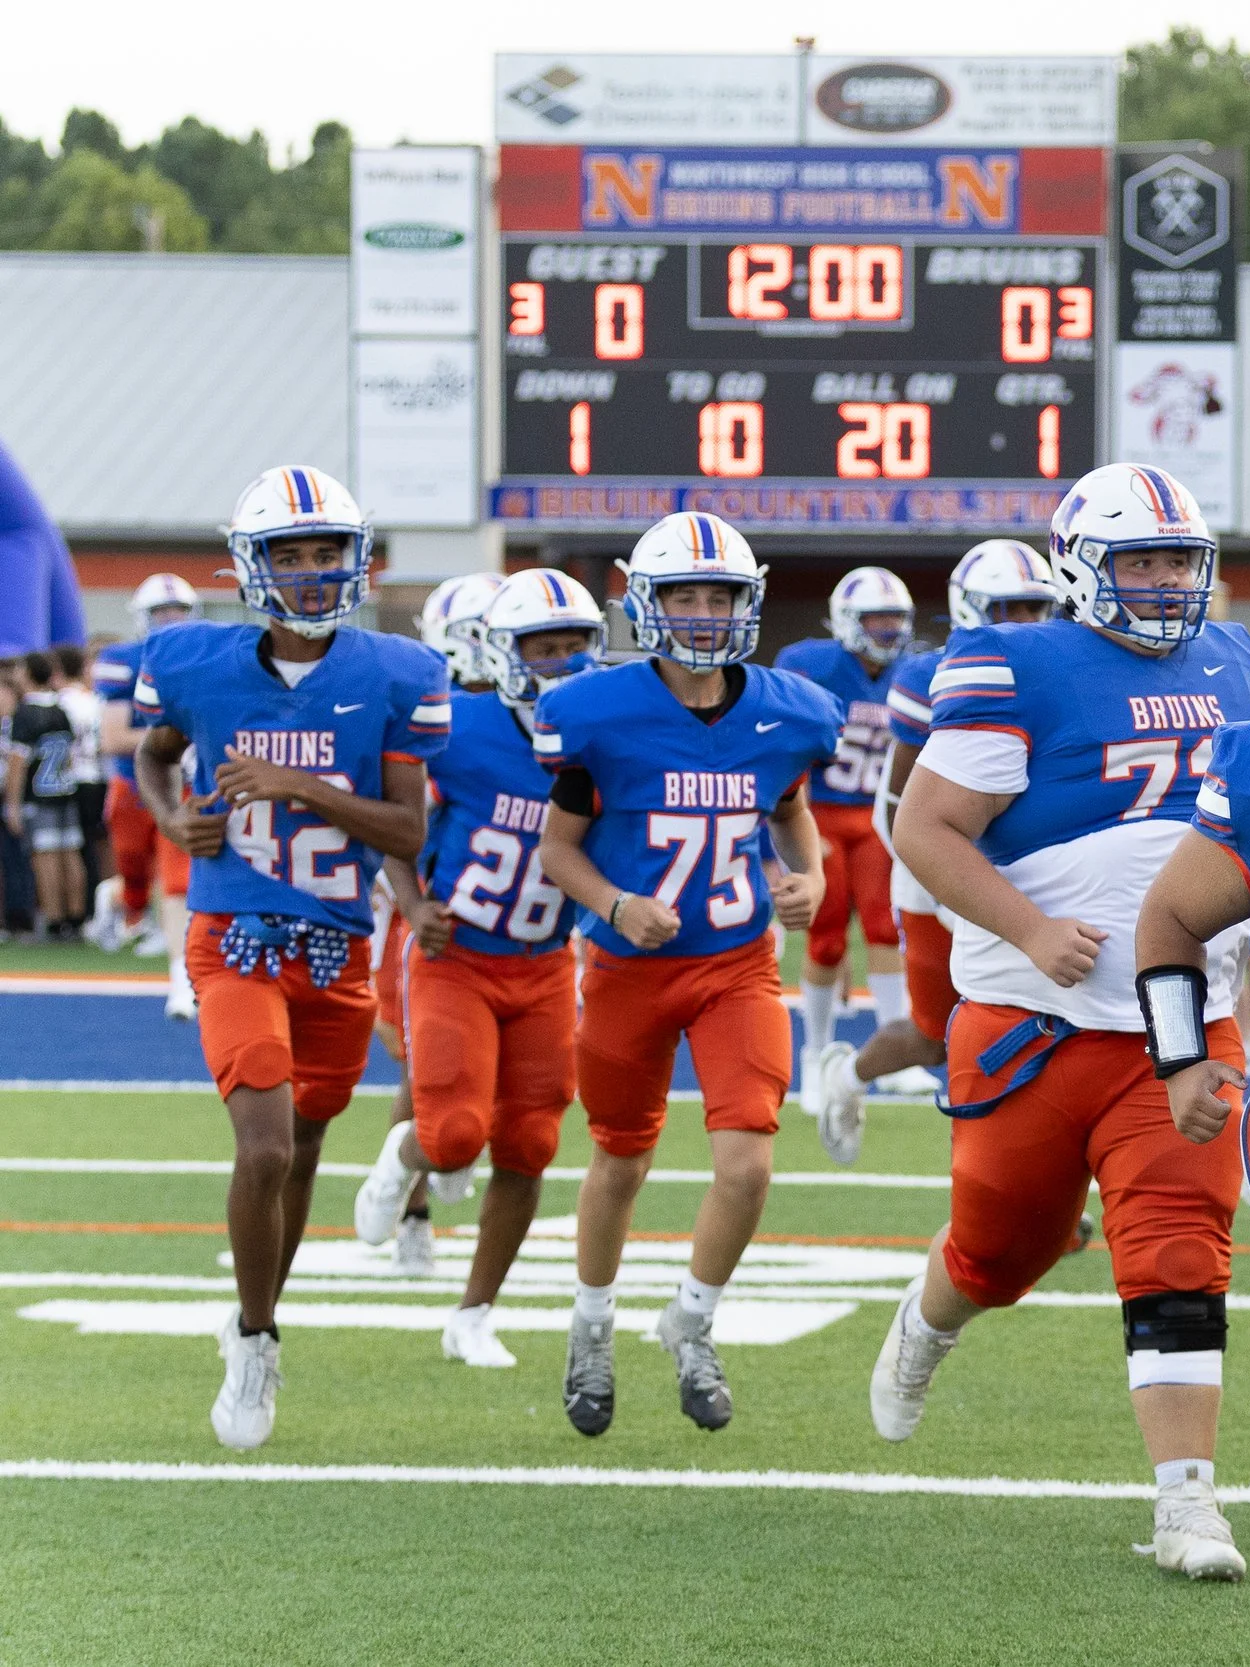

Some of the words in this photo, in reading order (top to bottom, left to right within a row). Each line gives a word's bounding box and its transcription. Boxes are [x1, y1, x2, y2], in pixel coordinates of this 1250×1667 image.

[586, 156, 661, 223] N
[782, 189, 933, 226] FOOTBALL
[940, 158, 1015, 223] N
[527, 245, 667, 281] GUEST
[727, 243, 904, 321] 12:00
[924, 247, 1084, 284] BRUINS
[508, 282, 545, 336] 3
[594, 283, 644, 360] 0
[1002, 287, 1051, 363] 0
[1057, 287, 1093, 339] 3
[514, 370, 617, 400] DOWN
[666, 370, 713, 401] TO
[716, 371, 767, 401] GO
[812, 372, 897, 402] BALL
[904, 373, 957, 402] ON
[569, 401, 592, 476] 1
[698, 401, 765, 478] 10
[836, 402, 932, 479] 20
[1037, 404, 1061, 479] 1
[541, 487, 672, 518] BRUIN
[684, 488, 897, 520] COUNTRY
[1158, 526, 1191, 535] Riddell
[1129, 694, 1227, 730] BRUINS
[236, 730, 335, 768] BRUINS
[664, 772, 756, 808] BRUINS
[226, 772, 361, 901] 42
[448, 826, 566, 942] 26
[647, 810, 761, 931] 75
